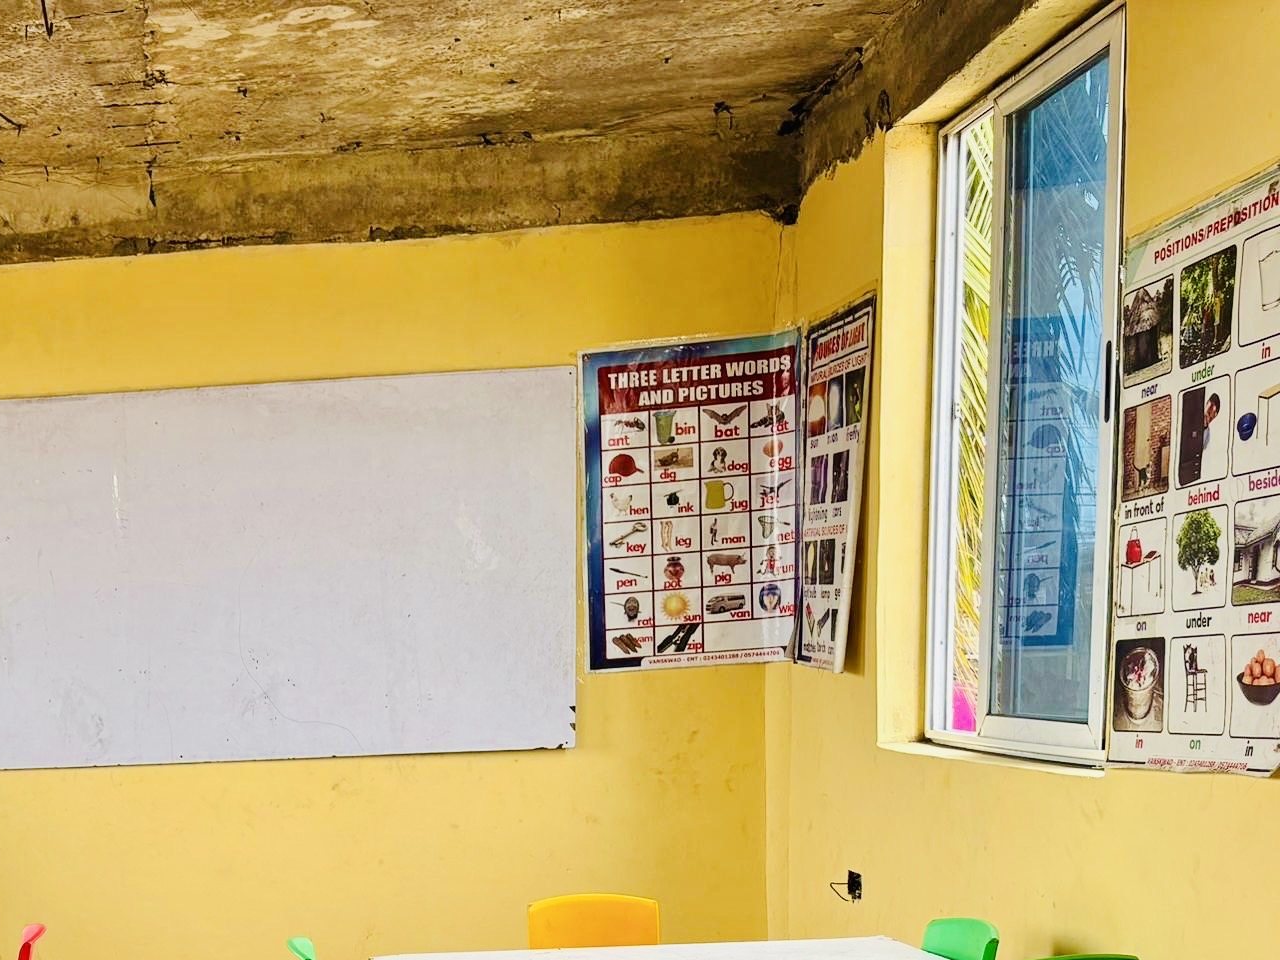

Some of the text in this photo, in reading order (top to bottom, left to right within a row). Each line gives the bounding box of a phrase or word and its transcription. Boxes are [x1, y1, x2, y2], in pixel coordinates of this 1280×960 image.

[1261, 342, 1271, 360] in
[608, 354, 791, 390] THREE LETTER WORDS
[1190, 362, 1215, 383] under
[638, 380, 764, 407] AND PICTURES
[1141, 383, 1158, 400] near
[675, 422, 696, 436] bin
[714, 424, 740, 438] bat
[607, 435, 630, 447] ant
[727, 460, 750, 473] dog
[769, 456, 792, 472] egg
[604, 475, 623, 487] cap
[660, 468, 677, 483] dig
[1248, 469, 1280, 492] besid
[1187, 484, 1221, 507] behind
[629, 505, 649, 516] hen
[677, 503, 695, 514] ink
[729, 498, 749, 511] jug
[1124, 495, 1165, 520] in front of
[675, 536, 692, 549] leg
[721, 535, 746, 546] man
[777, 531, 796, 542] net
[626, 542, 647, 554] key
[616, 578, 638, 591] pen
[663, 578, 683, 590] pot
[714, 572, 732, 585] pig
[778, 600, 796, 615] wig
[683, 614, 702, 623] sun
[729, 609, 751, 620] van
[1185, 612, 1212, 629] under
[1247, 611, 1273, 624] near
[637, 616, 654, 627] rat
[1135, 621, 1147, 632] on
[687, 639, 703, 655] zip
[1134, 734, 1144, 750] in
[1189, 738, 1201, 751] on
[1244, 739, 1254, 757] in
